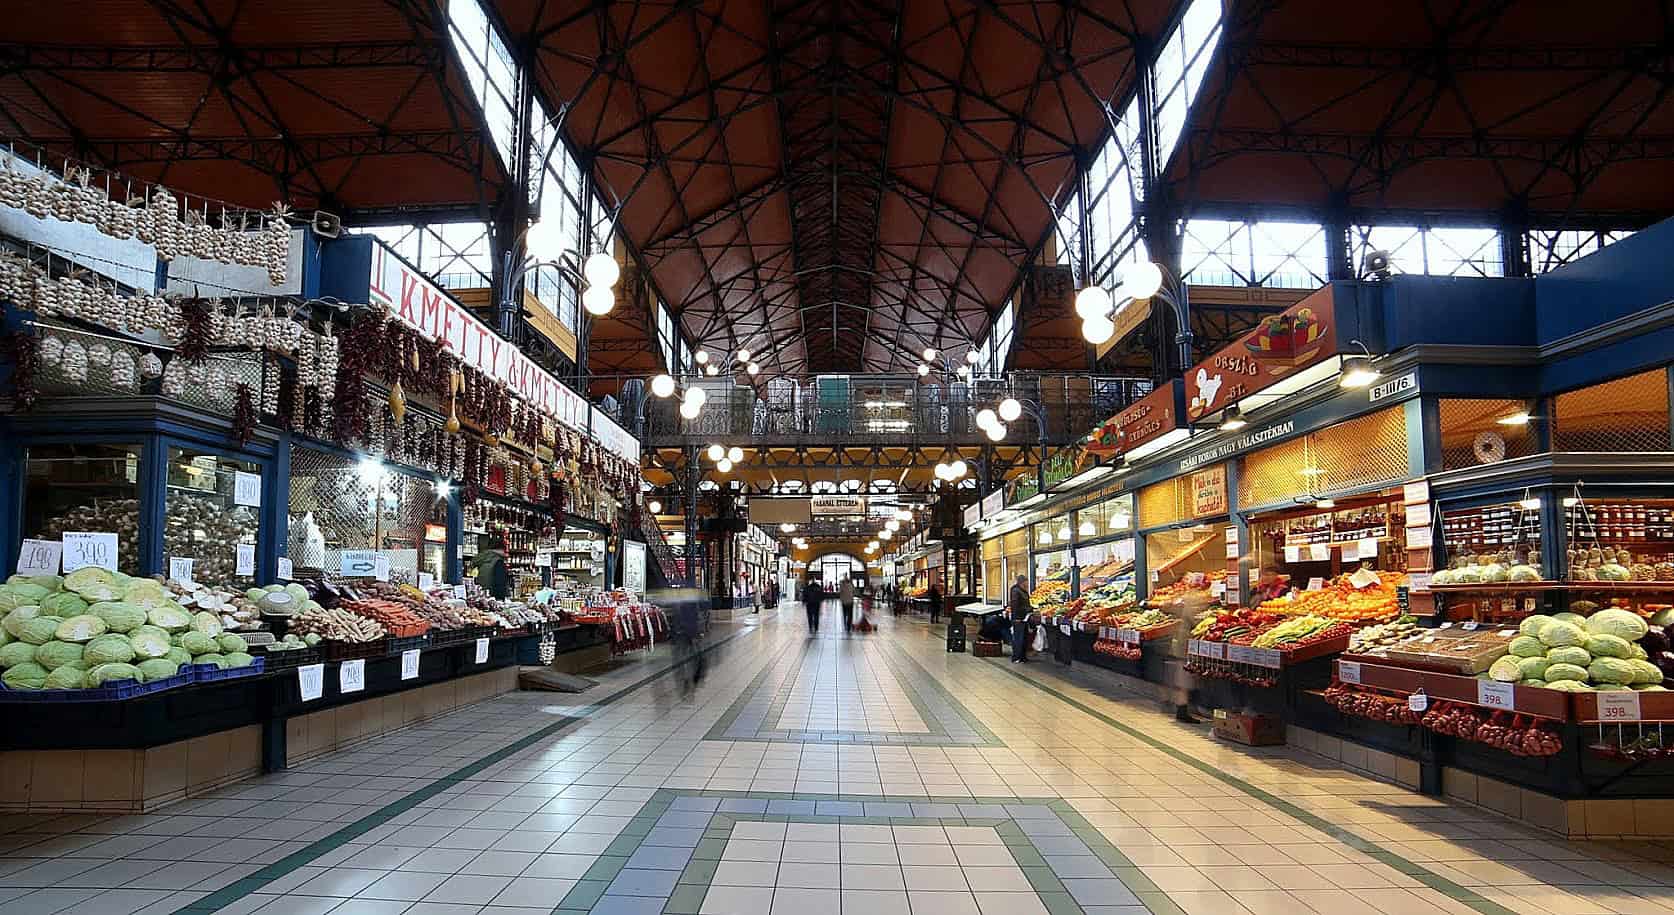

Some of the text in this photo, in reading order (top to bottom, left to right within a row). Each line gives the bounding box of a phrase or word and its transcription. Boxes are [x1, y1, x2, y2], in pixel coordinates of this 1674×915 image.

[399, 268, 501, 376] KMETTY
[1215, 355, 1257, 376] ORSZÁG
[1238, 421, 1294, 450] VÁLASZTÉKBAN
[1484, 694, 1501, 705] 398
[1605, 707, 1626, 717] 398
